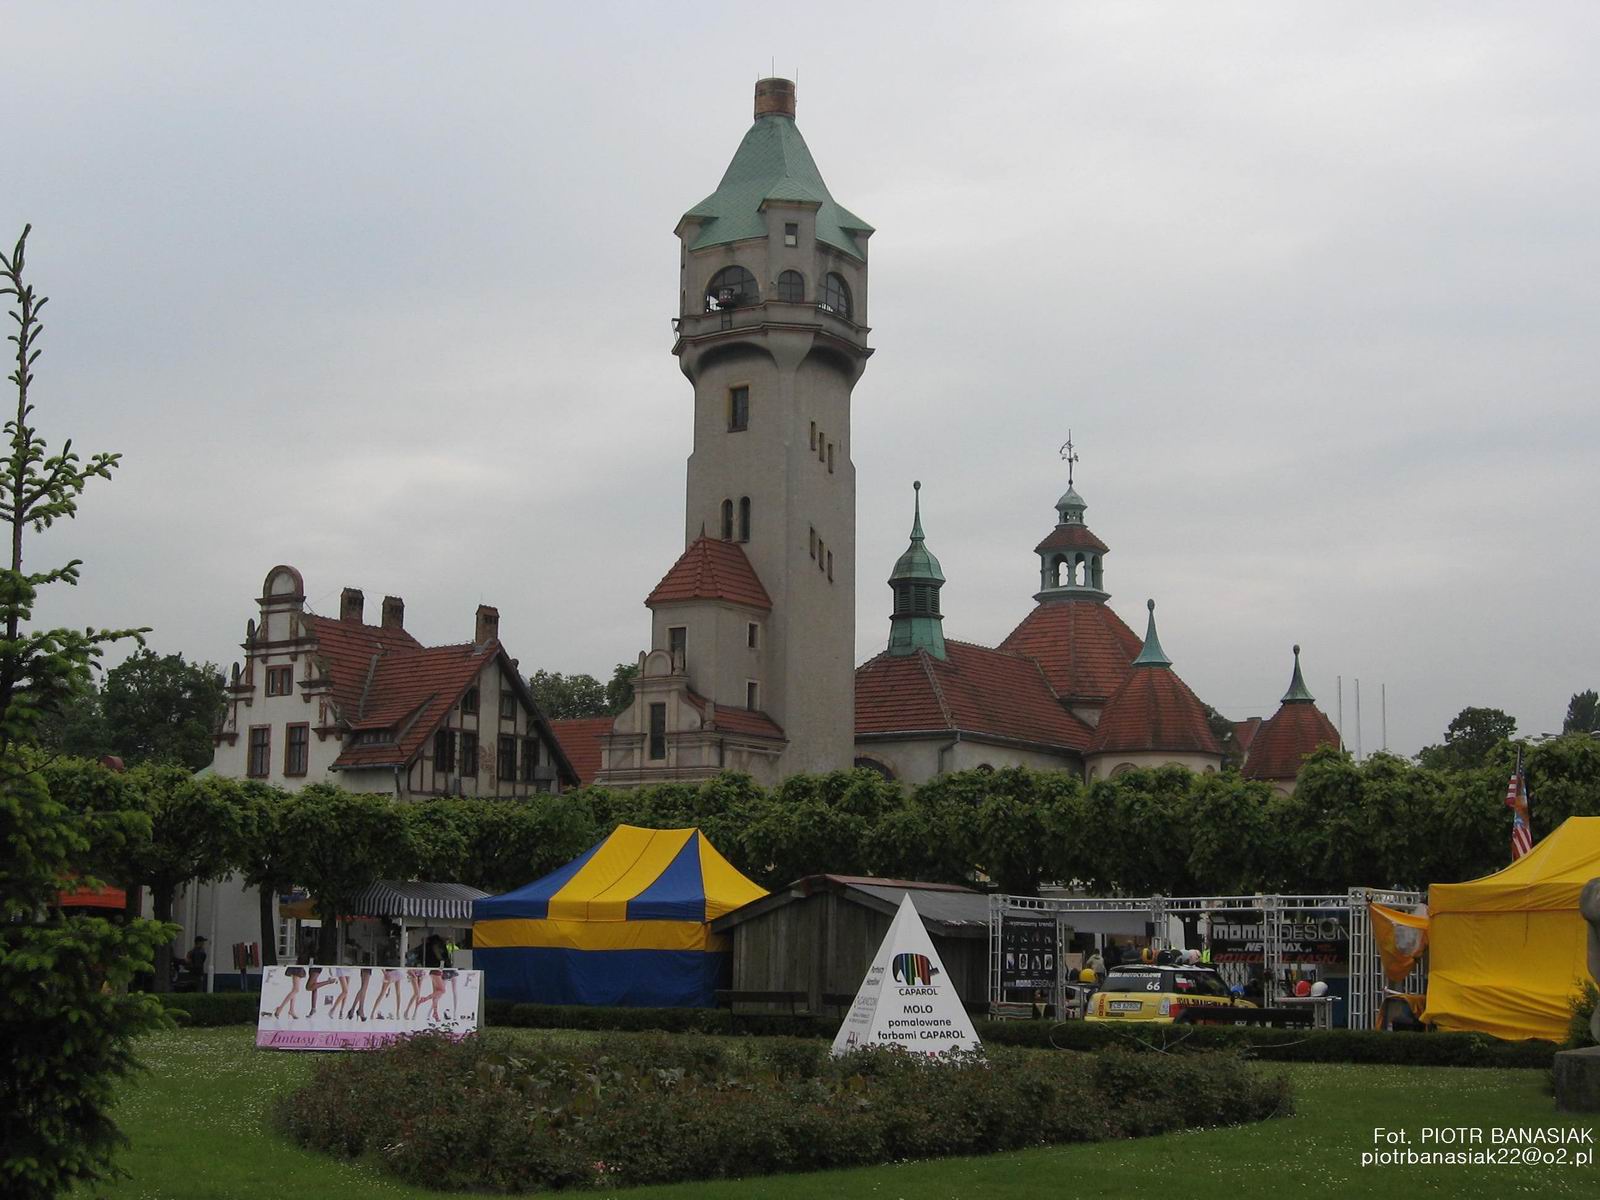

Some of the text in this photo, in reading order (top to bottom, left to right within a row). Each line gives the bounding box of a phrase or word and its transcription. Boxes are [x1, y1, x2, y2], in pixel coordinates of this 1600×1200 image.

[1146, 981, 1161, 991] 66
[898, 988, 938, 996] CAPAROL
[903, 1004, 933, 1014] MOLO
[888, 1018, 952, 1029] pomalowane
[877, 1030, 965, 1040] farbami CAPAROL
